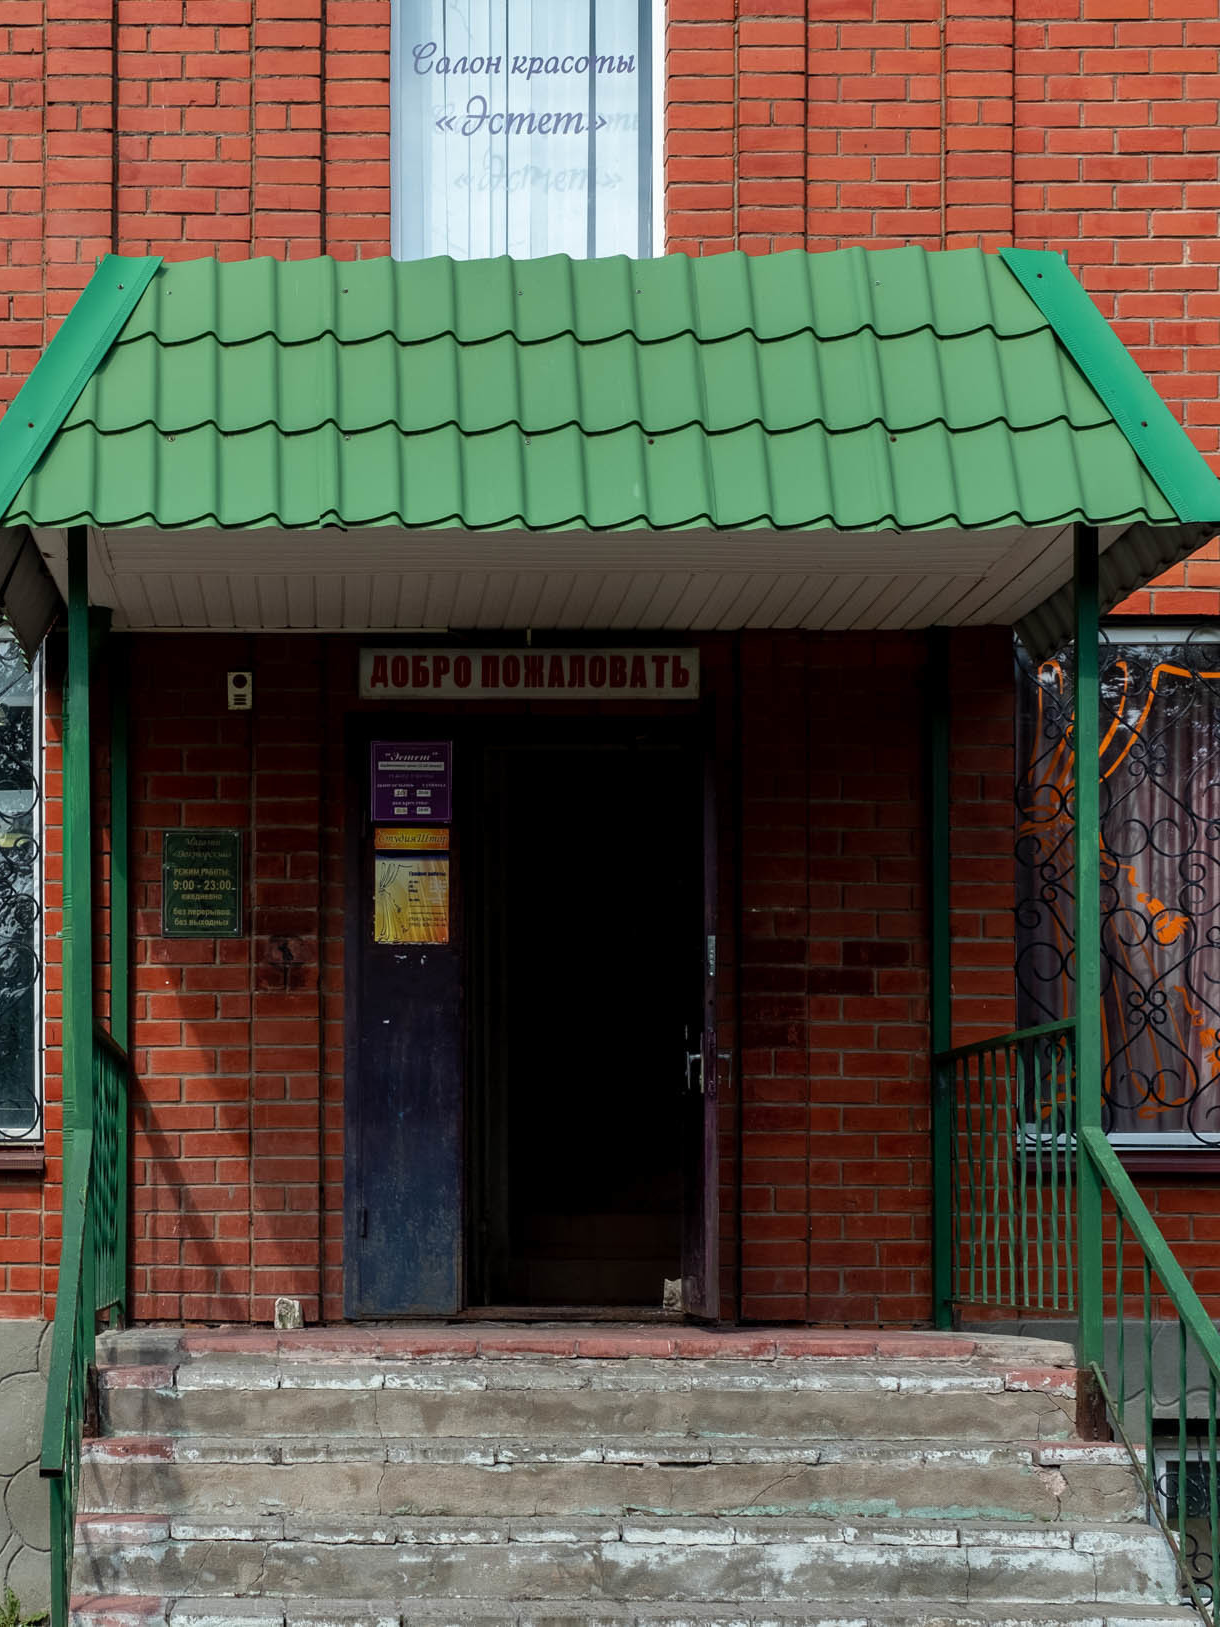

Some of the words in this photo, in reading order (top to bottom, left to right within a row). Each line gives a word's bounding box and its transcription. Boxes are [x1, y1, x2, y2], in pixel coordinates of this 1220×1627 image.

[412, 42, 502, 75] Салон
[511, 54, 636, 80] красоты
[435, 95, 607, 137] «Эстет»
[371, 655, 472, 688] ДОБРО
[481, 655, 689, 688] ПОЖАЛОВАТЬ
[173, 880, 195, 891] 9:00
